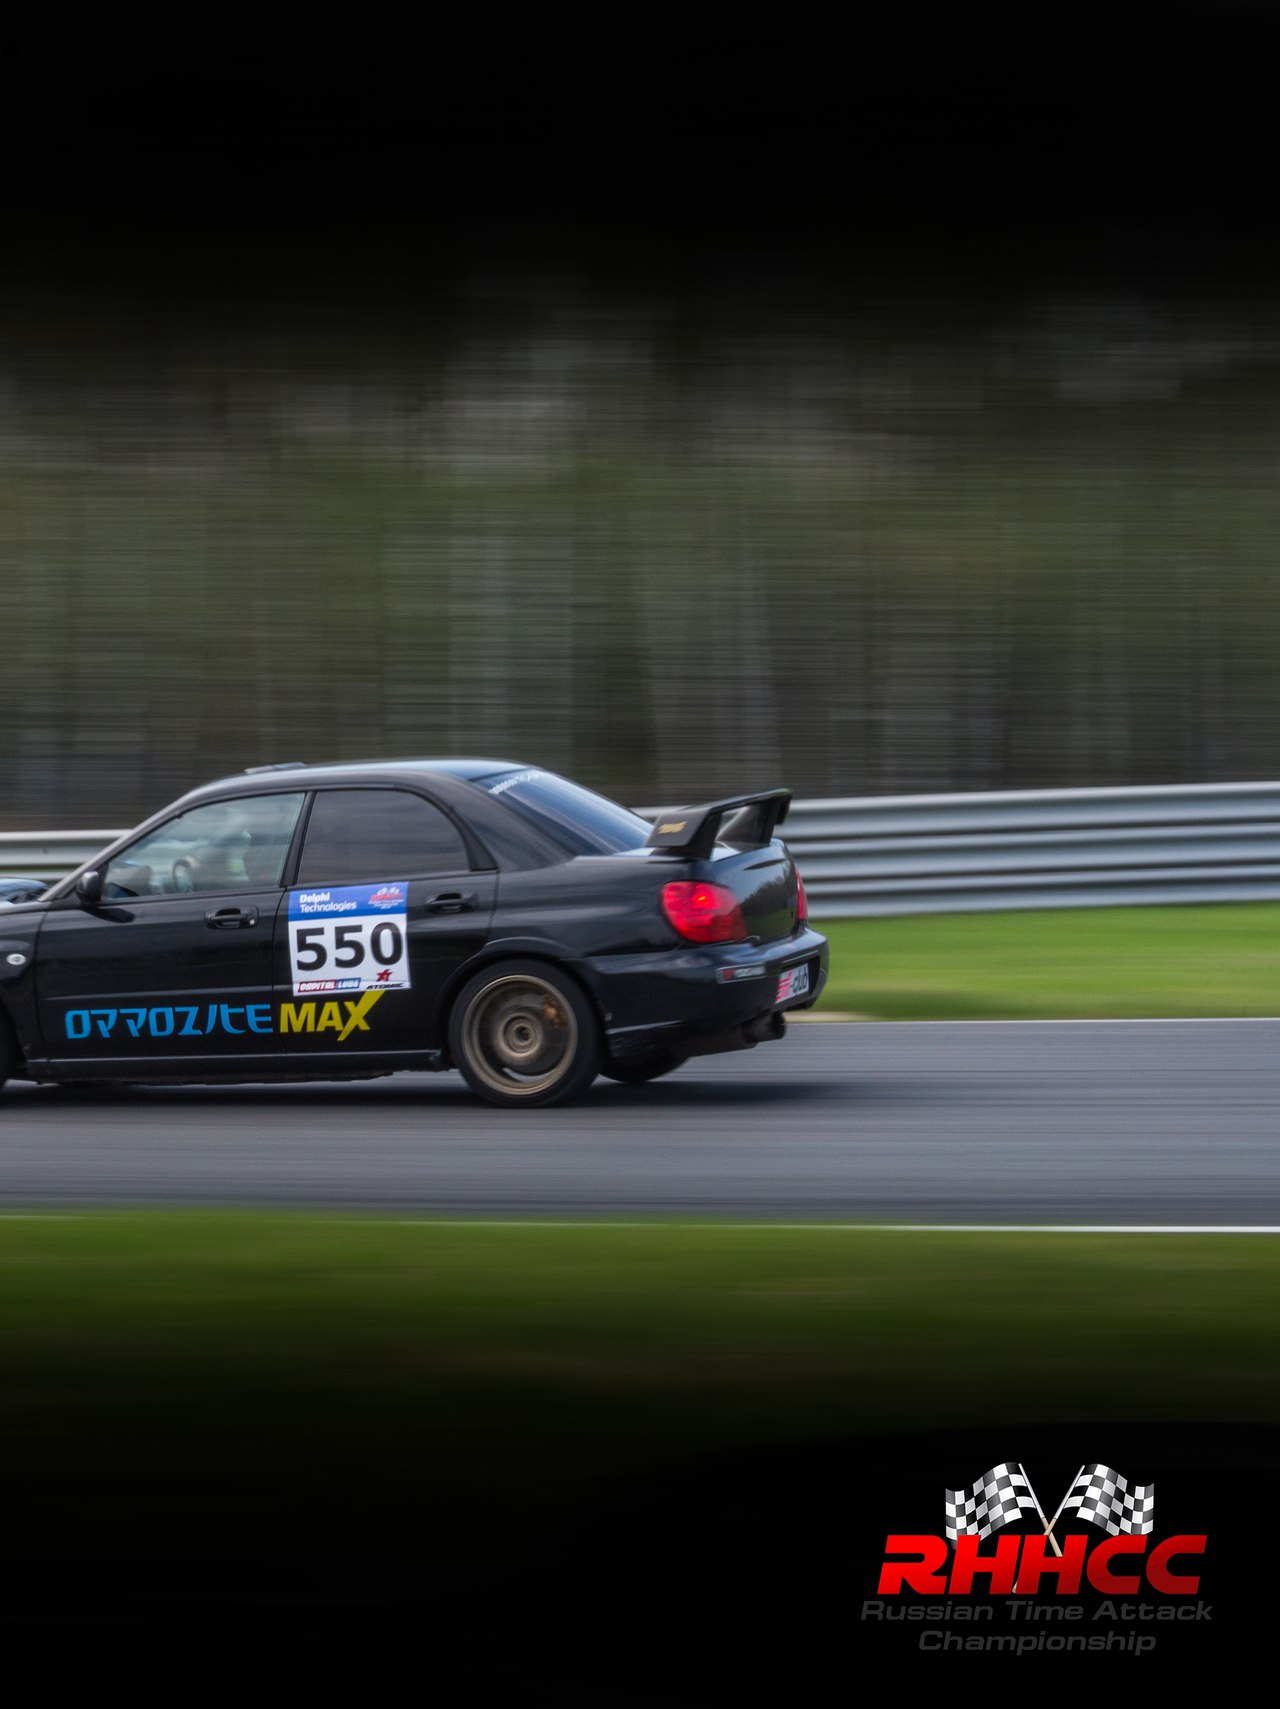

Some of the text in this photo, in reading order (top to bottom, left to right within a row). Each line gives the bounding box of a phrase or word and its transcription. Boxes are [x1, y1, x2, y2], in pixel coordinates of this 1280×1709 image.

[300, 892, 330, 903] Delphi
[300, 901, 357, 913] Technologies
[296, 922, 403, 971] 550
[280, 990, 386, 1041] MAX
